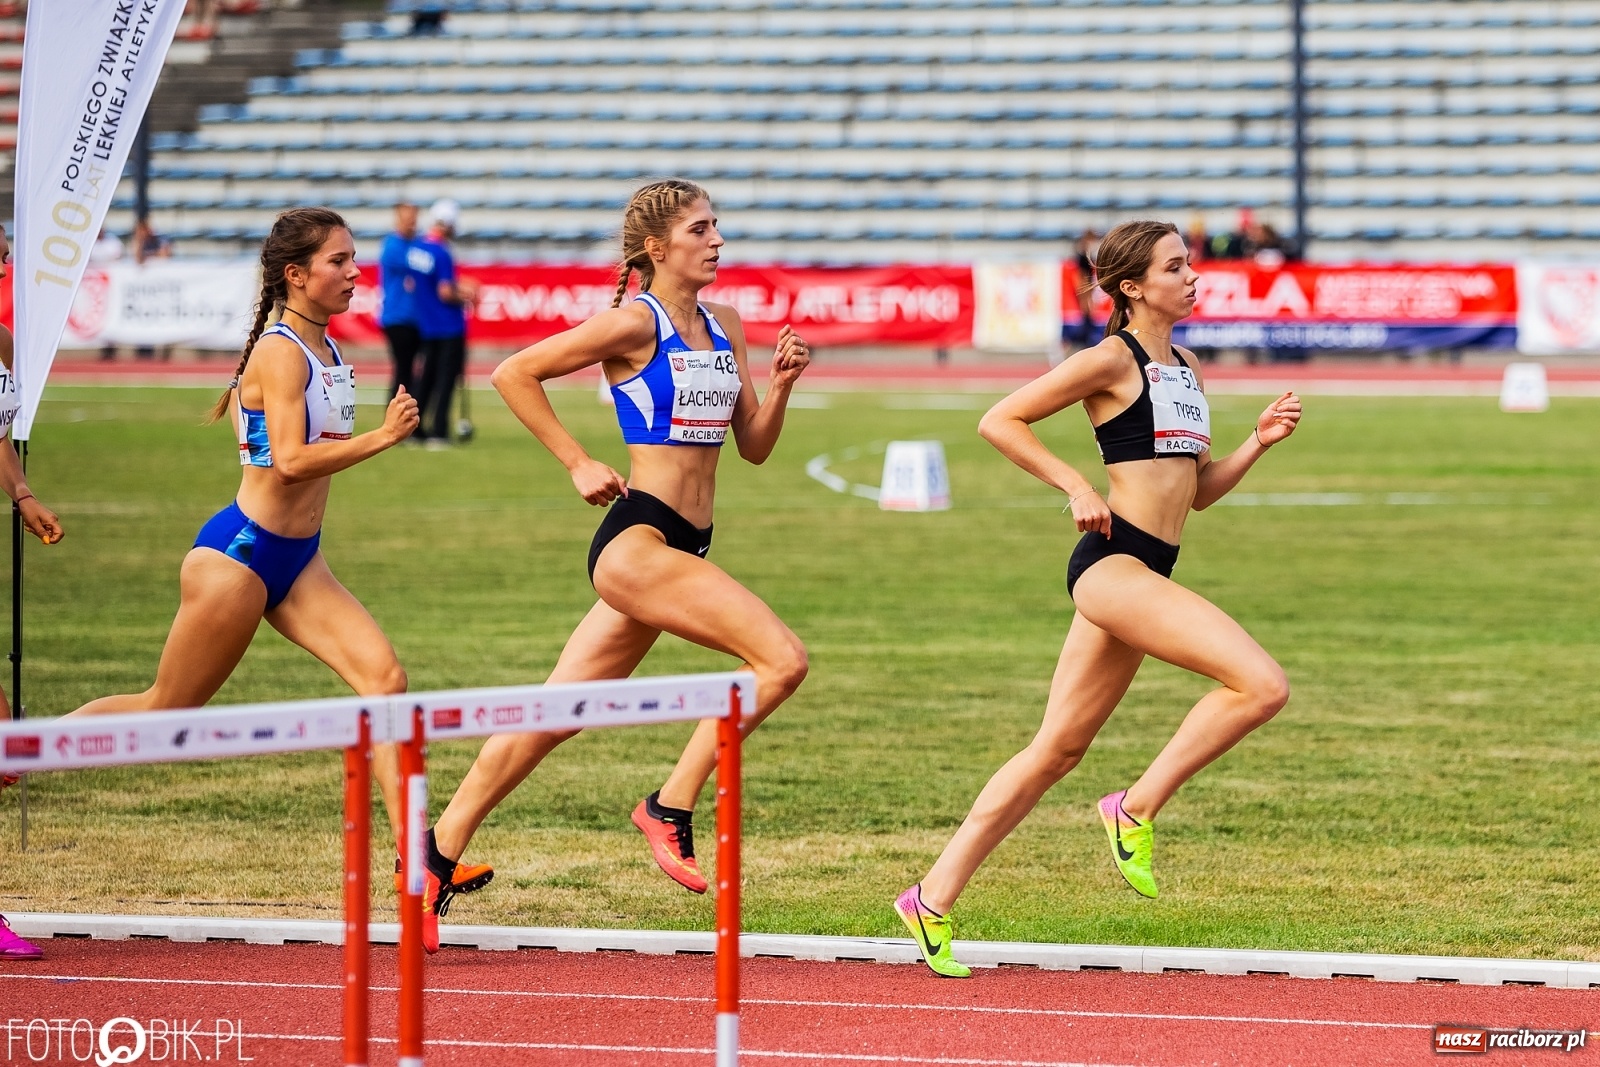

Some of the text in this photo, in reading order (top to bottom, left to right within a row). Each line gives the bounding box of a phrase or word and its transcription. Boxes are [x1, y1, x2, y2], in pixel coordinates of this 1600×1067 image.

[61, 0, 135, 192] POLSKIEGO ZWIĄZK
[83, 0, 158, 200] LAT LEKKIEJ ATLETYK
[34, 200, 92, 289] 100
[714, 354, 738, 375] 48
[1173, 401, 1204, 423] TYPER
